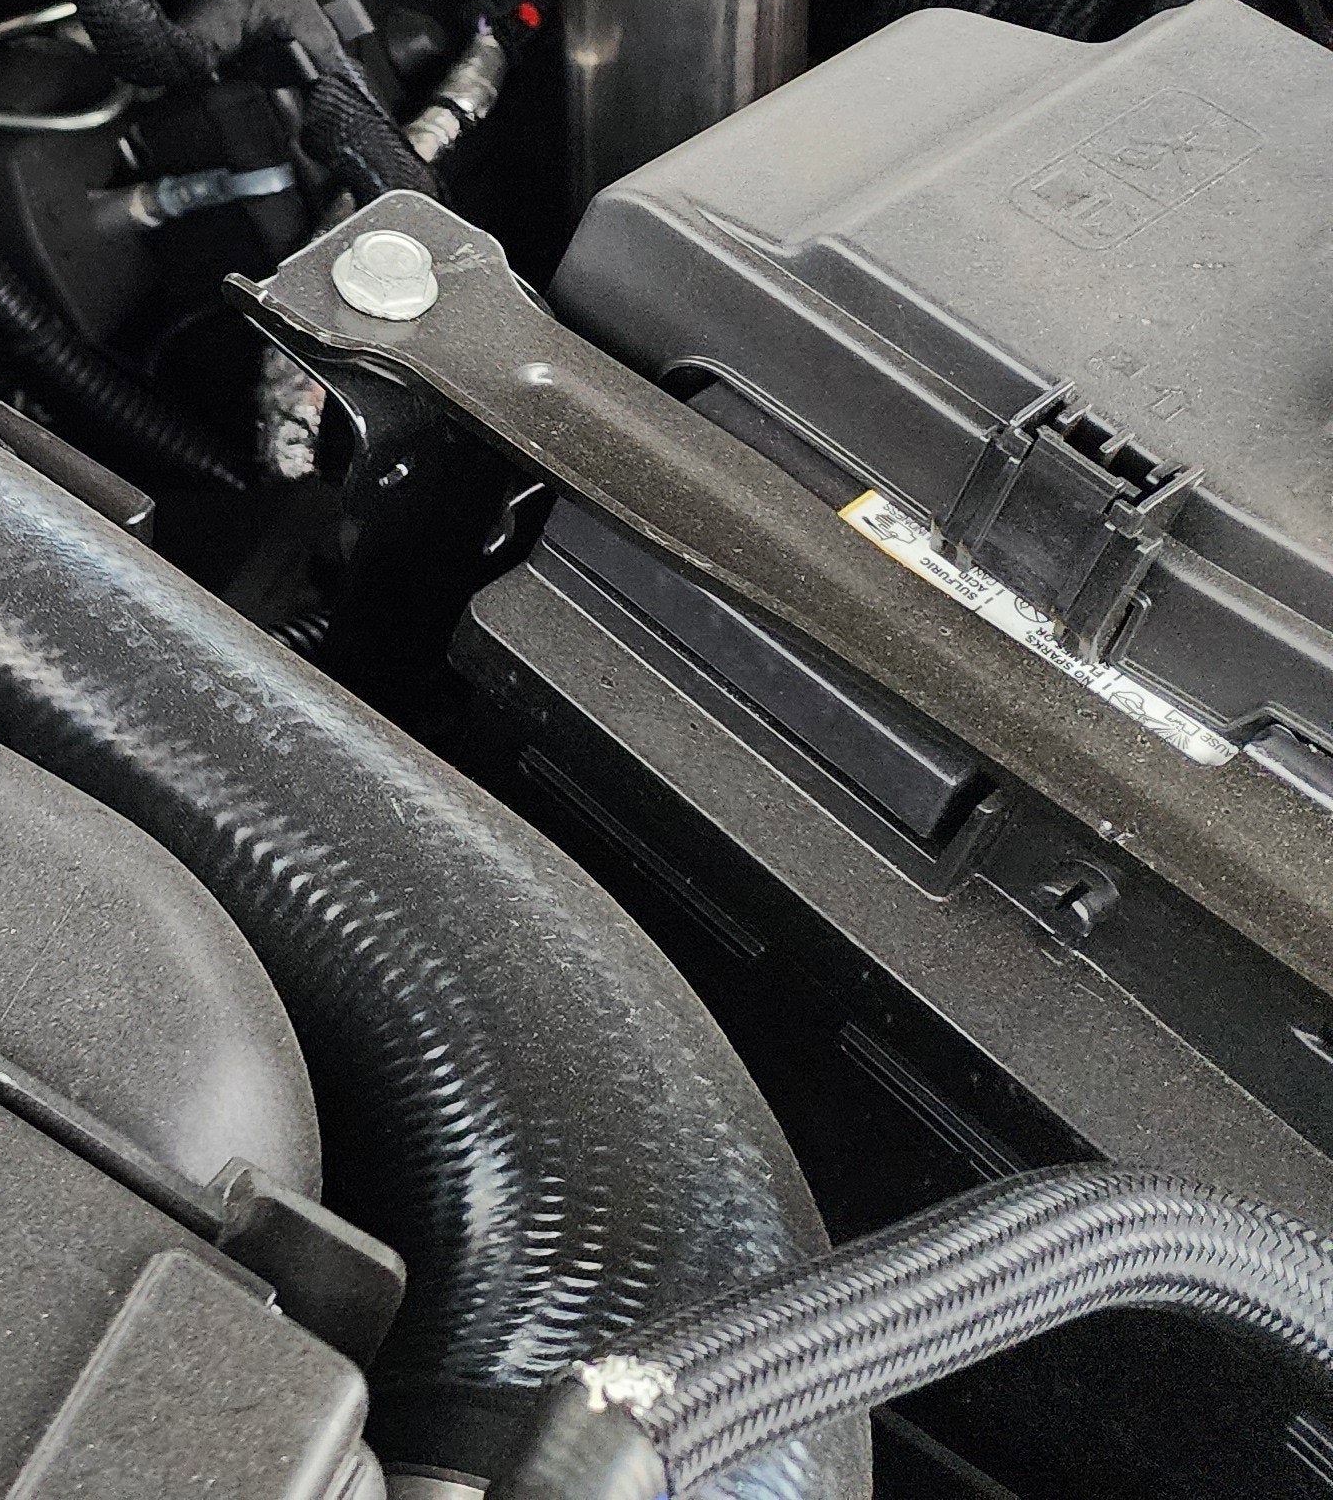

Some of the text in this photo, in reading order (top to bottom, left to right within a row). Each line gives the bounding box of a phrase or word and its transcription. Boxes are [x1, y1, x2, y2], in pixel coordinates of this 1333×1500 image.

[919, 557, 979, 601] SULFURIC
[958, 570, 989, 593] ACID
[1036, 626, 1056, 643] OR
[1026, 630, 1095, 689] NO SPARKS,
